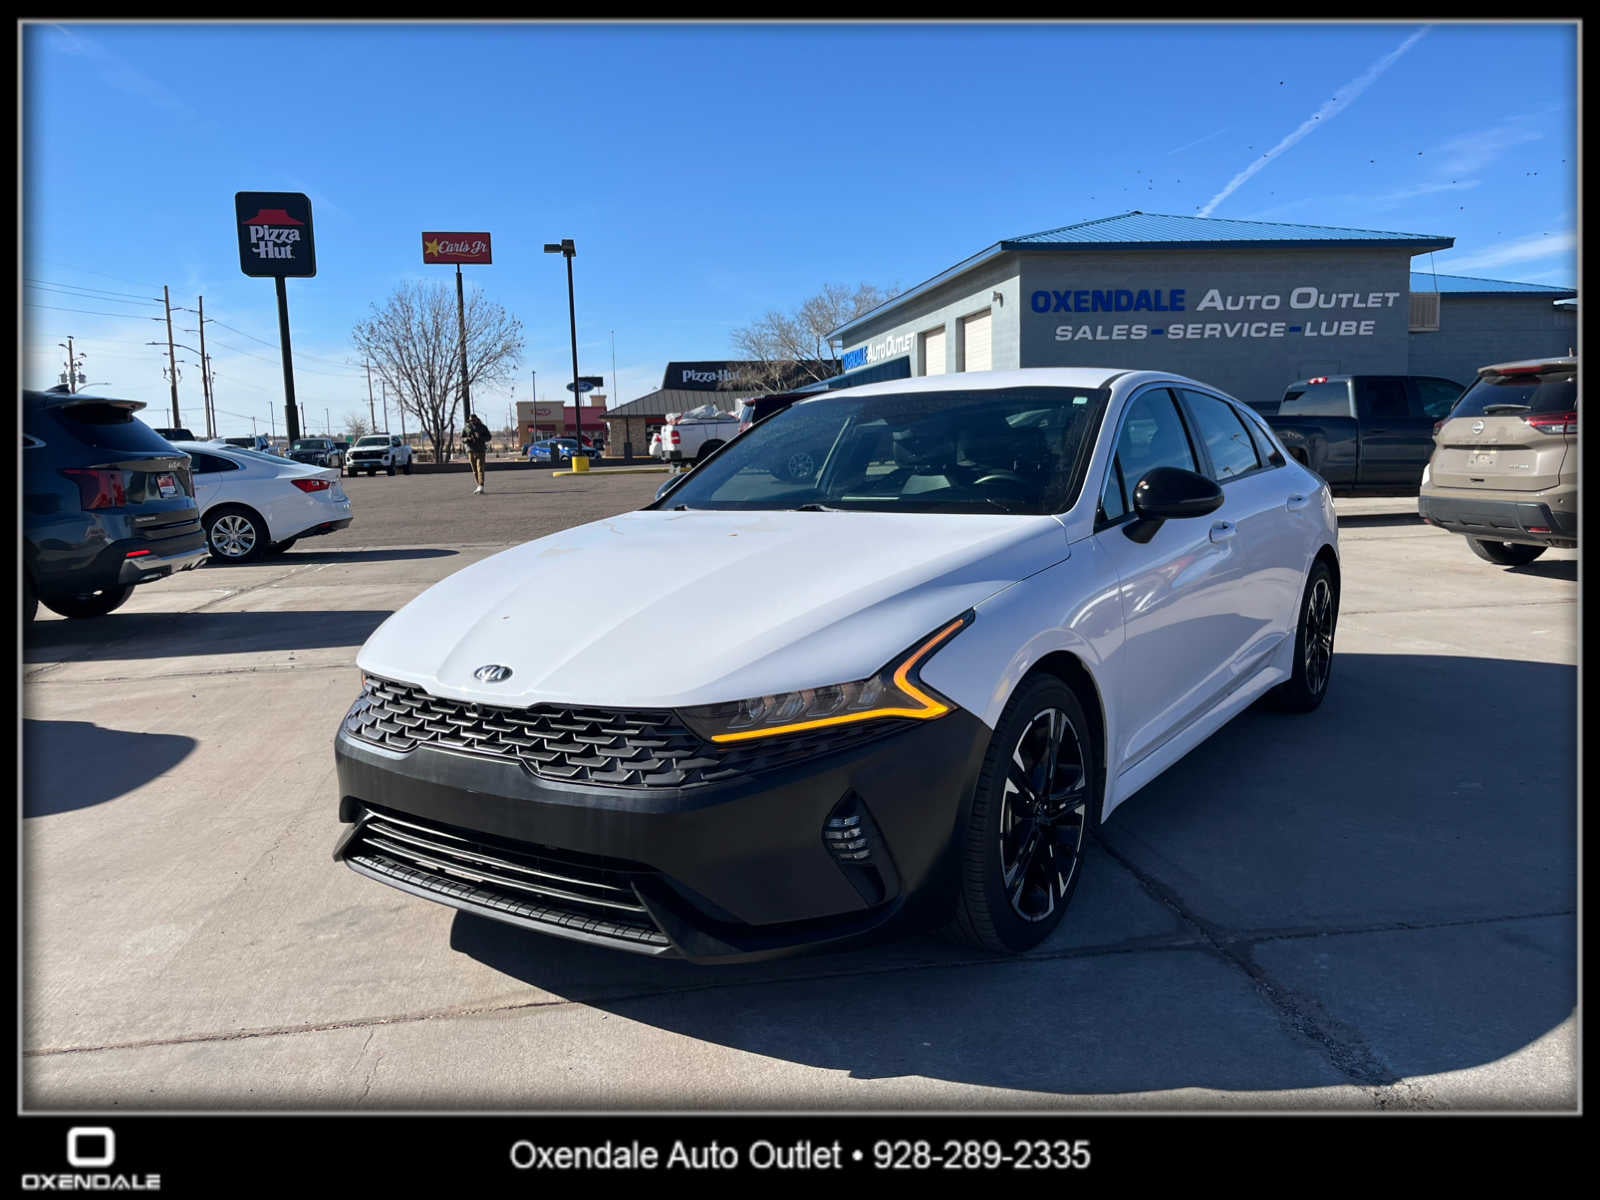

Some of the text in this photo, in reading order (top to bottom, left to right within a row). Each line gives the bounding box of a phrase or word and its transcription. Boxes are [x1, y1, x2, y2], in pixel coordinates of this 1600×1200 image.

[249, 225, 301, 244] Pizza
[252, 240, 296, 259] Hut
[1031, 286, 1400, 313] OXENDALE AUTO OUTLET
[682, 369, 716, 383] Pizza
